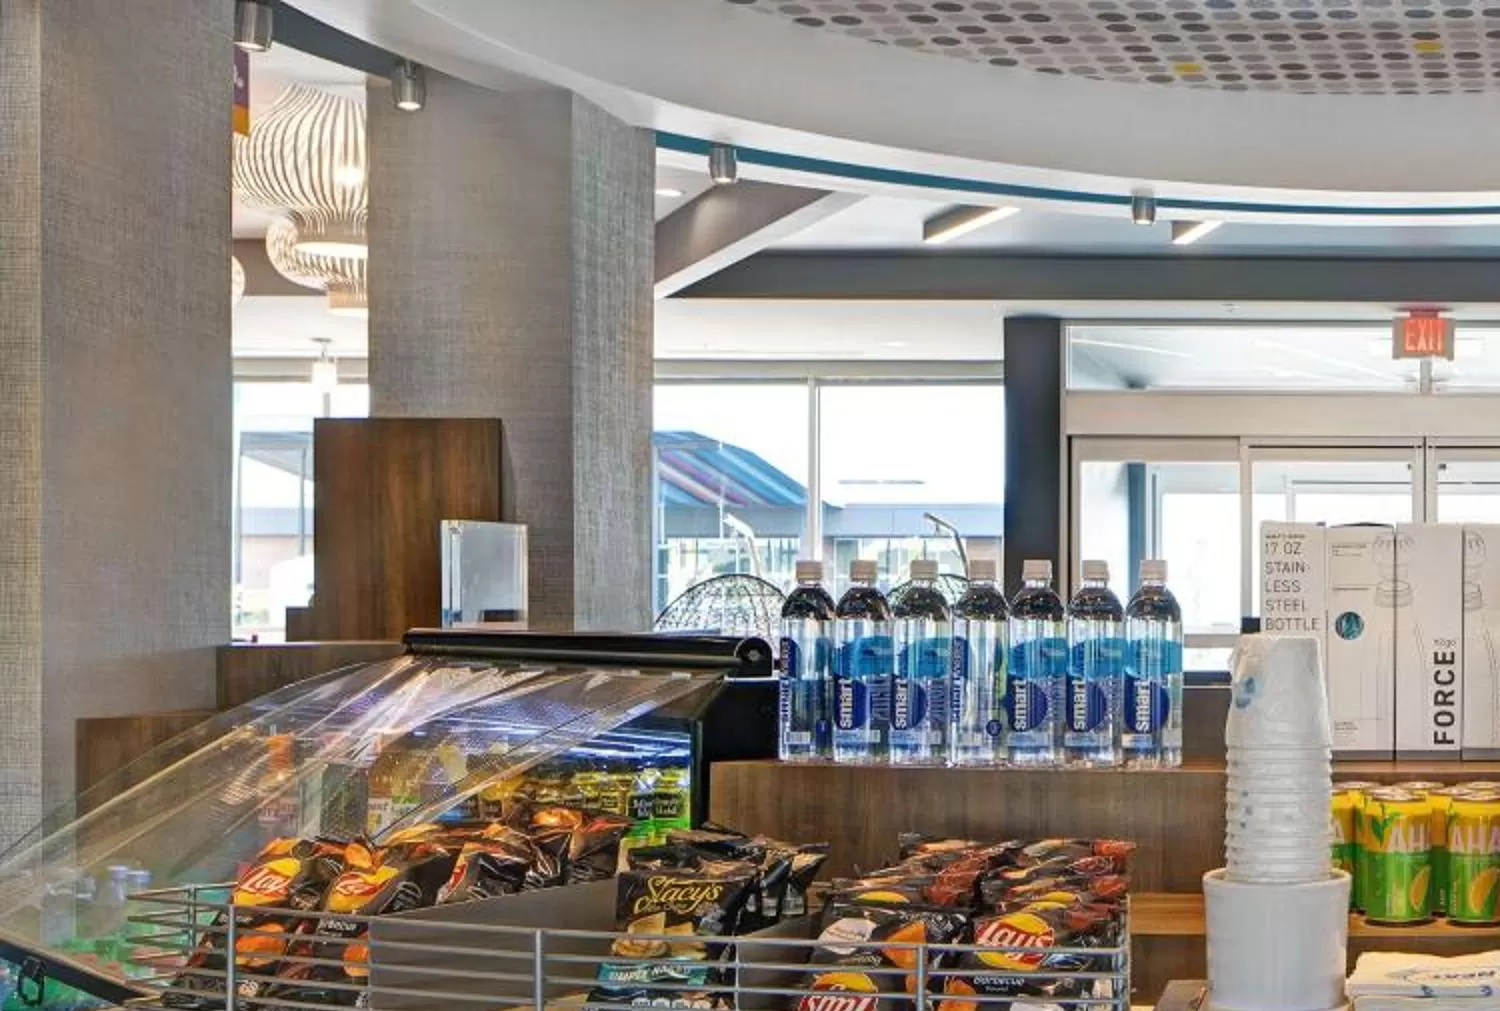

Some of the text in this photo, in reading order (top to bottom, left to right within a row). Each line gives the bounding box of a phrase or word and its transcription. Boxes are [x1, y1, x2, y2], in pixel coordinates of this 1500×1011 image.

[1265, 580, 1302, 593] LESS
[1265, 600, 1306, 613] STEEL
[1265, 618, 1320, 631] BOTTLE
[1433, 651, 1455, 745] FORCE
